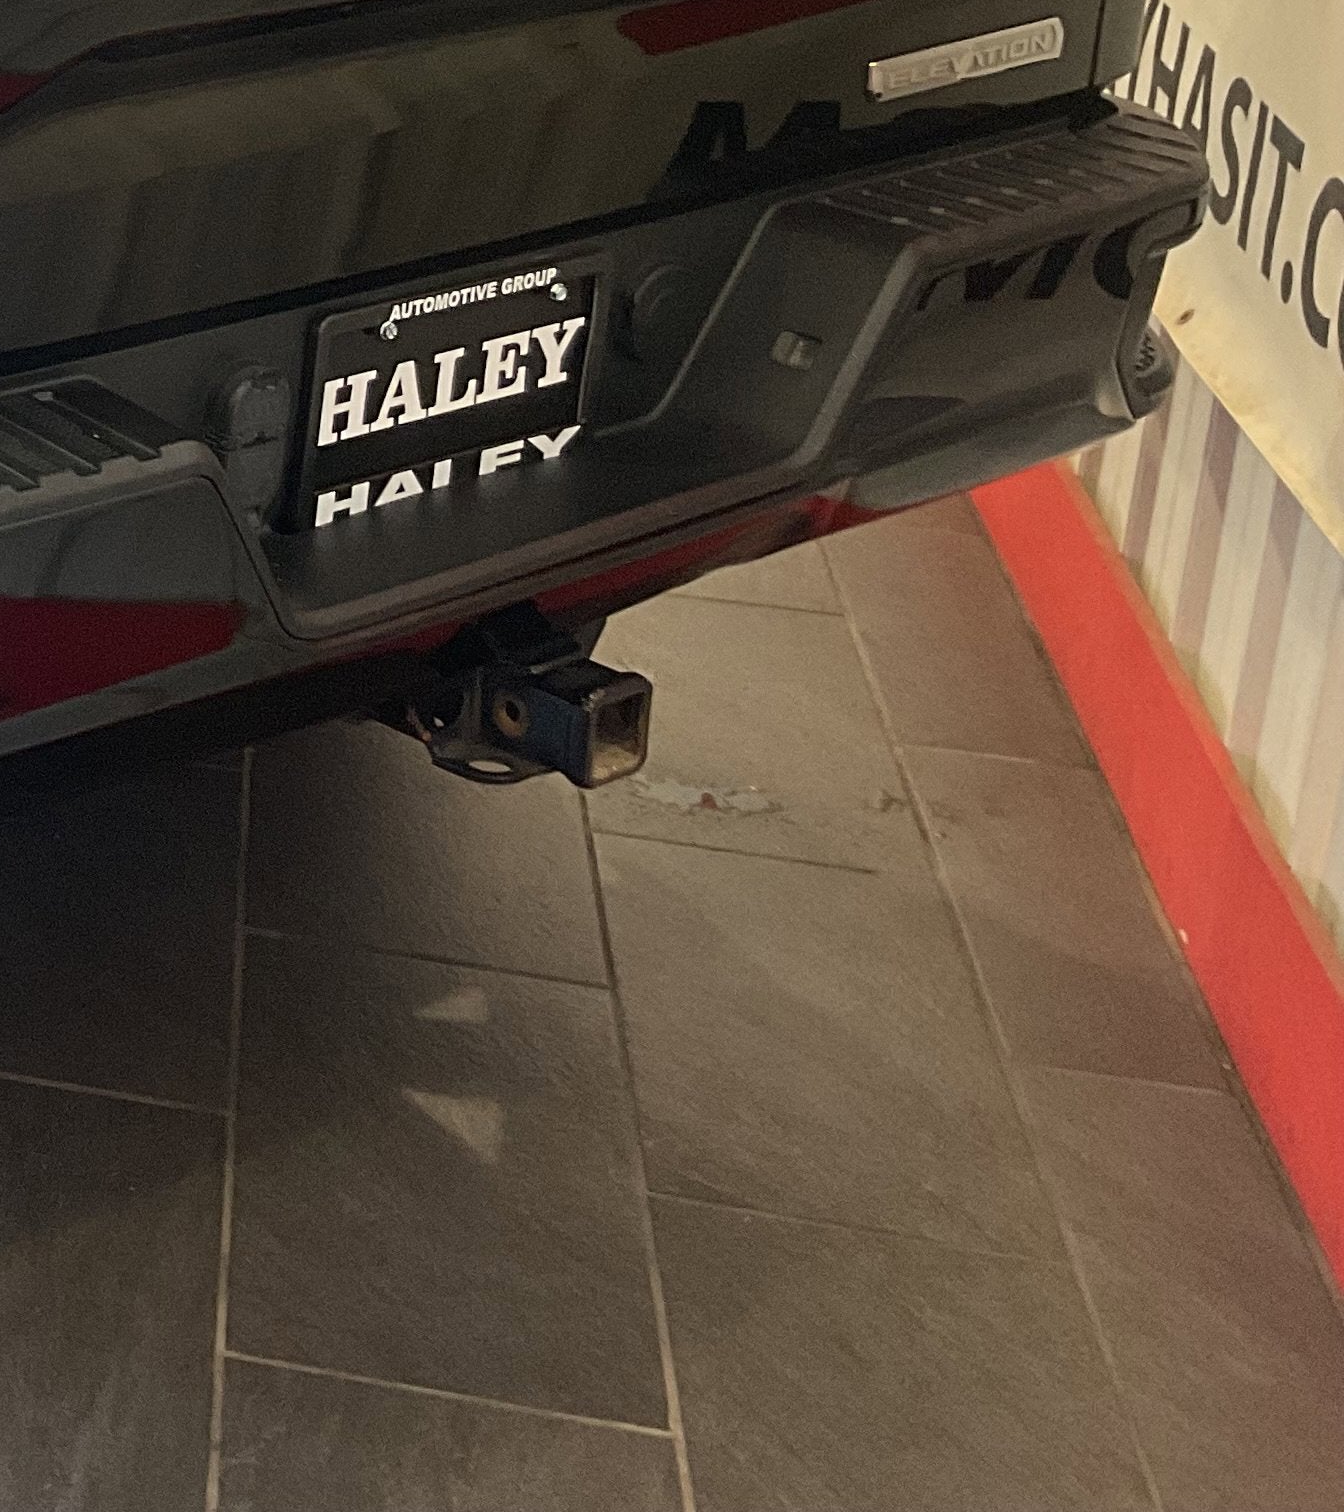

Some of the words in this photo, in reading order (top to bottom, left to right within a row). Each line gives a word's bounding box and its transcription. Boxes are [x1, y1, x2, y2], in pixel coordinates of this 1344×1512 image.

[888, 31, 1051, 90] ELEVATION
[389, 280, 499, 322] AUTOMOTIVE
[500, 267, 558, 295] GROUP
[317, 316, 586, 447] HALEY
